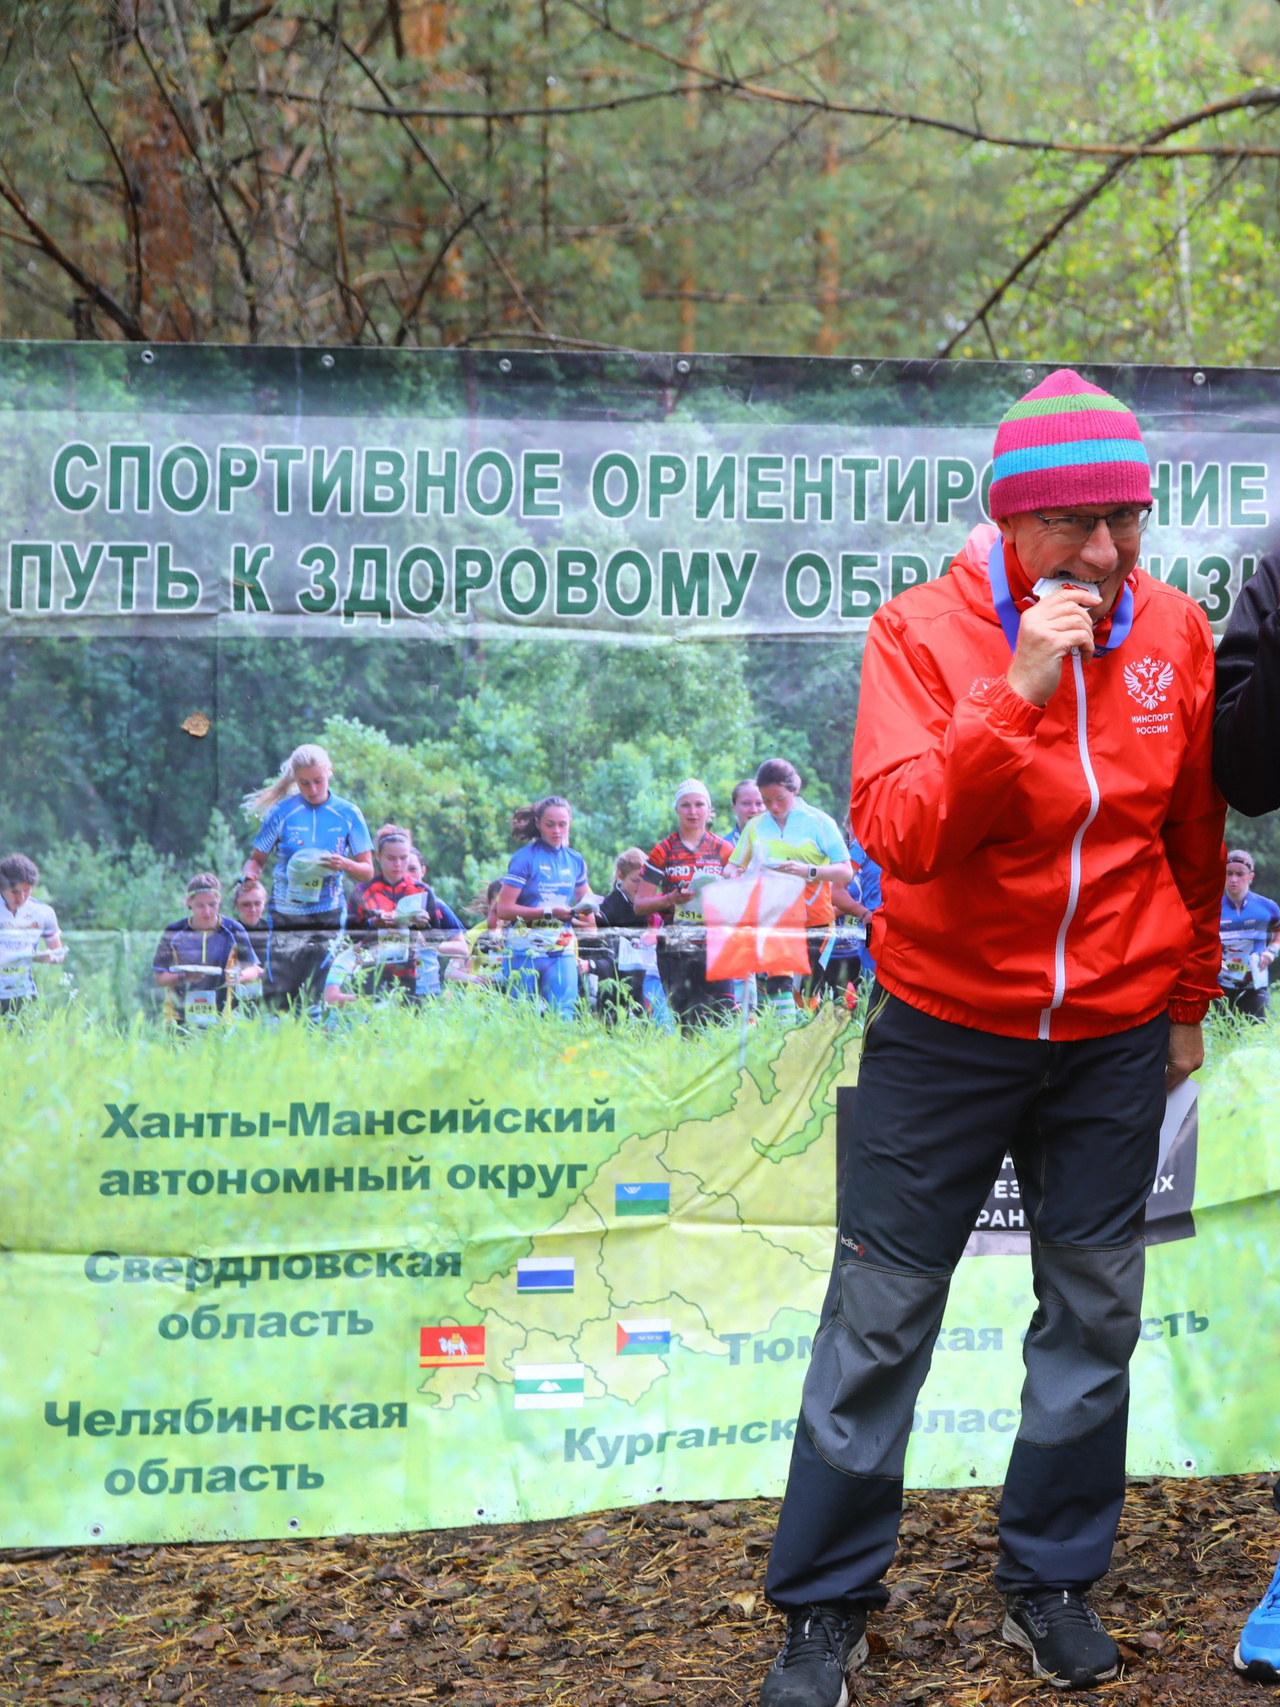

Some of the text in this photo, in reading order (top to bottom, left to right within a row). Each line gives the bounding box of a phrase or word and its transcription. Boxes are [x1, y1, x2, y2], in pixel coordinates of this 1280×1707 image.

[52, 442, 562, 517] СПОРТИВНОЕ
[9, 541, 203, 613] ПУТЬ
[230, 544, 273, 614] К
[297, 544, 760, 626] ЗДОРОВОМУ
[1131, 713, 1174, 723] МИНСПОРТ
[1136, 725, 1168, 735] РОССИИ
[101, 1098, 617, 1140] Ханты-Мансийский
[99, 1155, 589, 1199] автономный округ
[83, 1249, 463, 1290] Свердловская
[157, 1304, 375, 1342] область
[44, 1397, 409, 1438] Челябинская
[563, 1417, 799, 1470] Курганск
[104, 1458, 325, 1496] область
